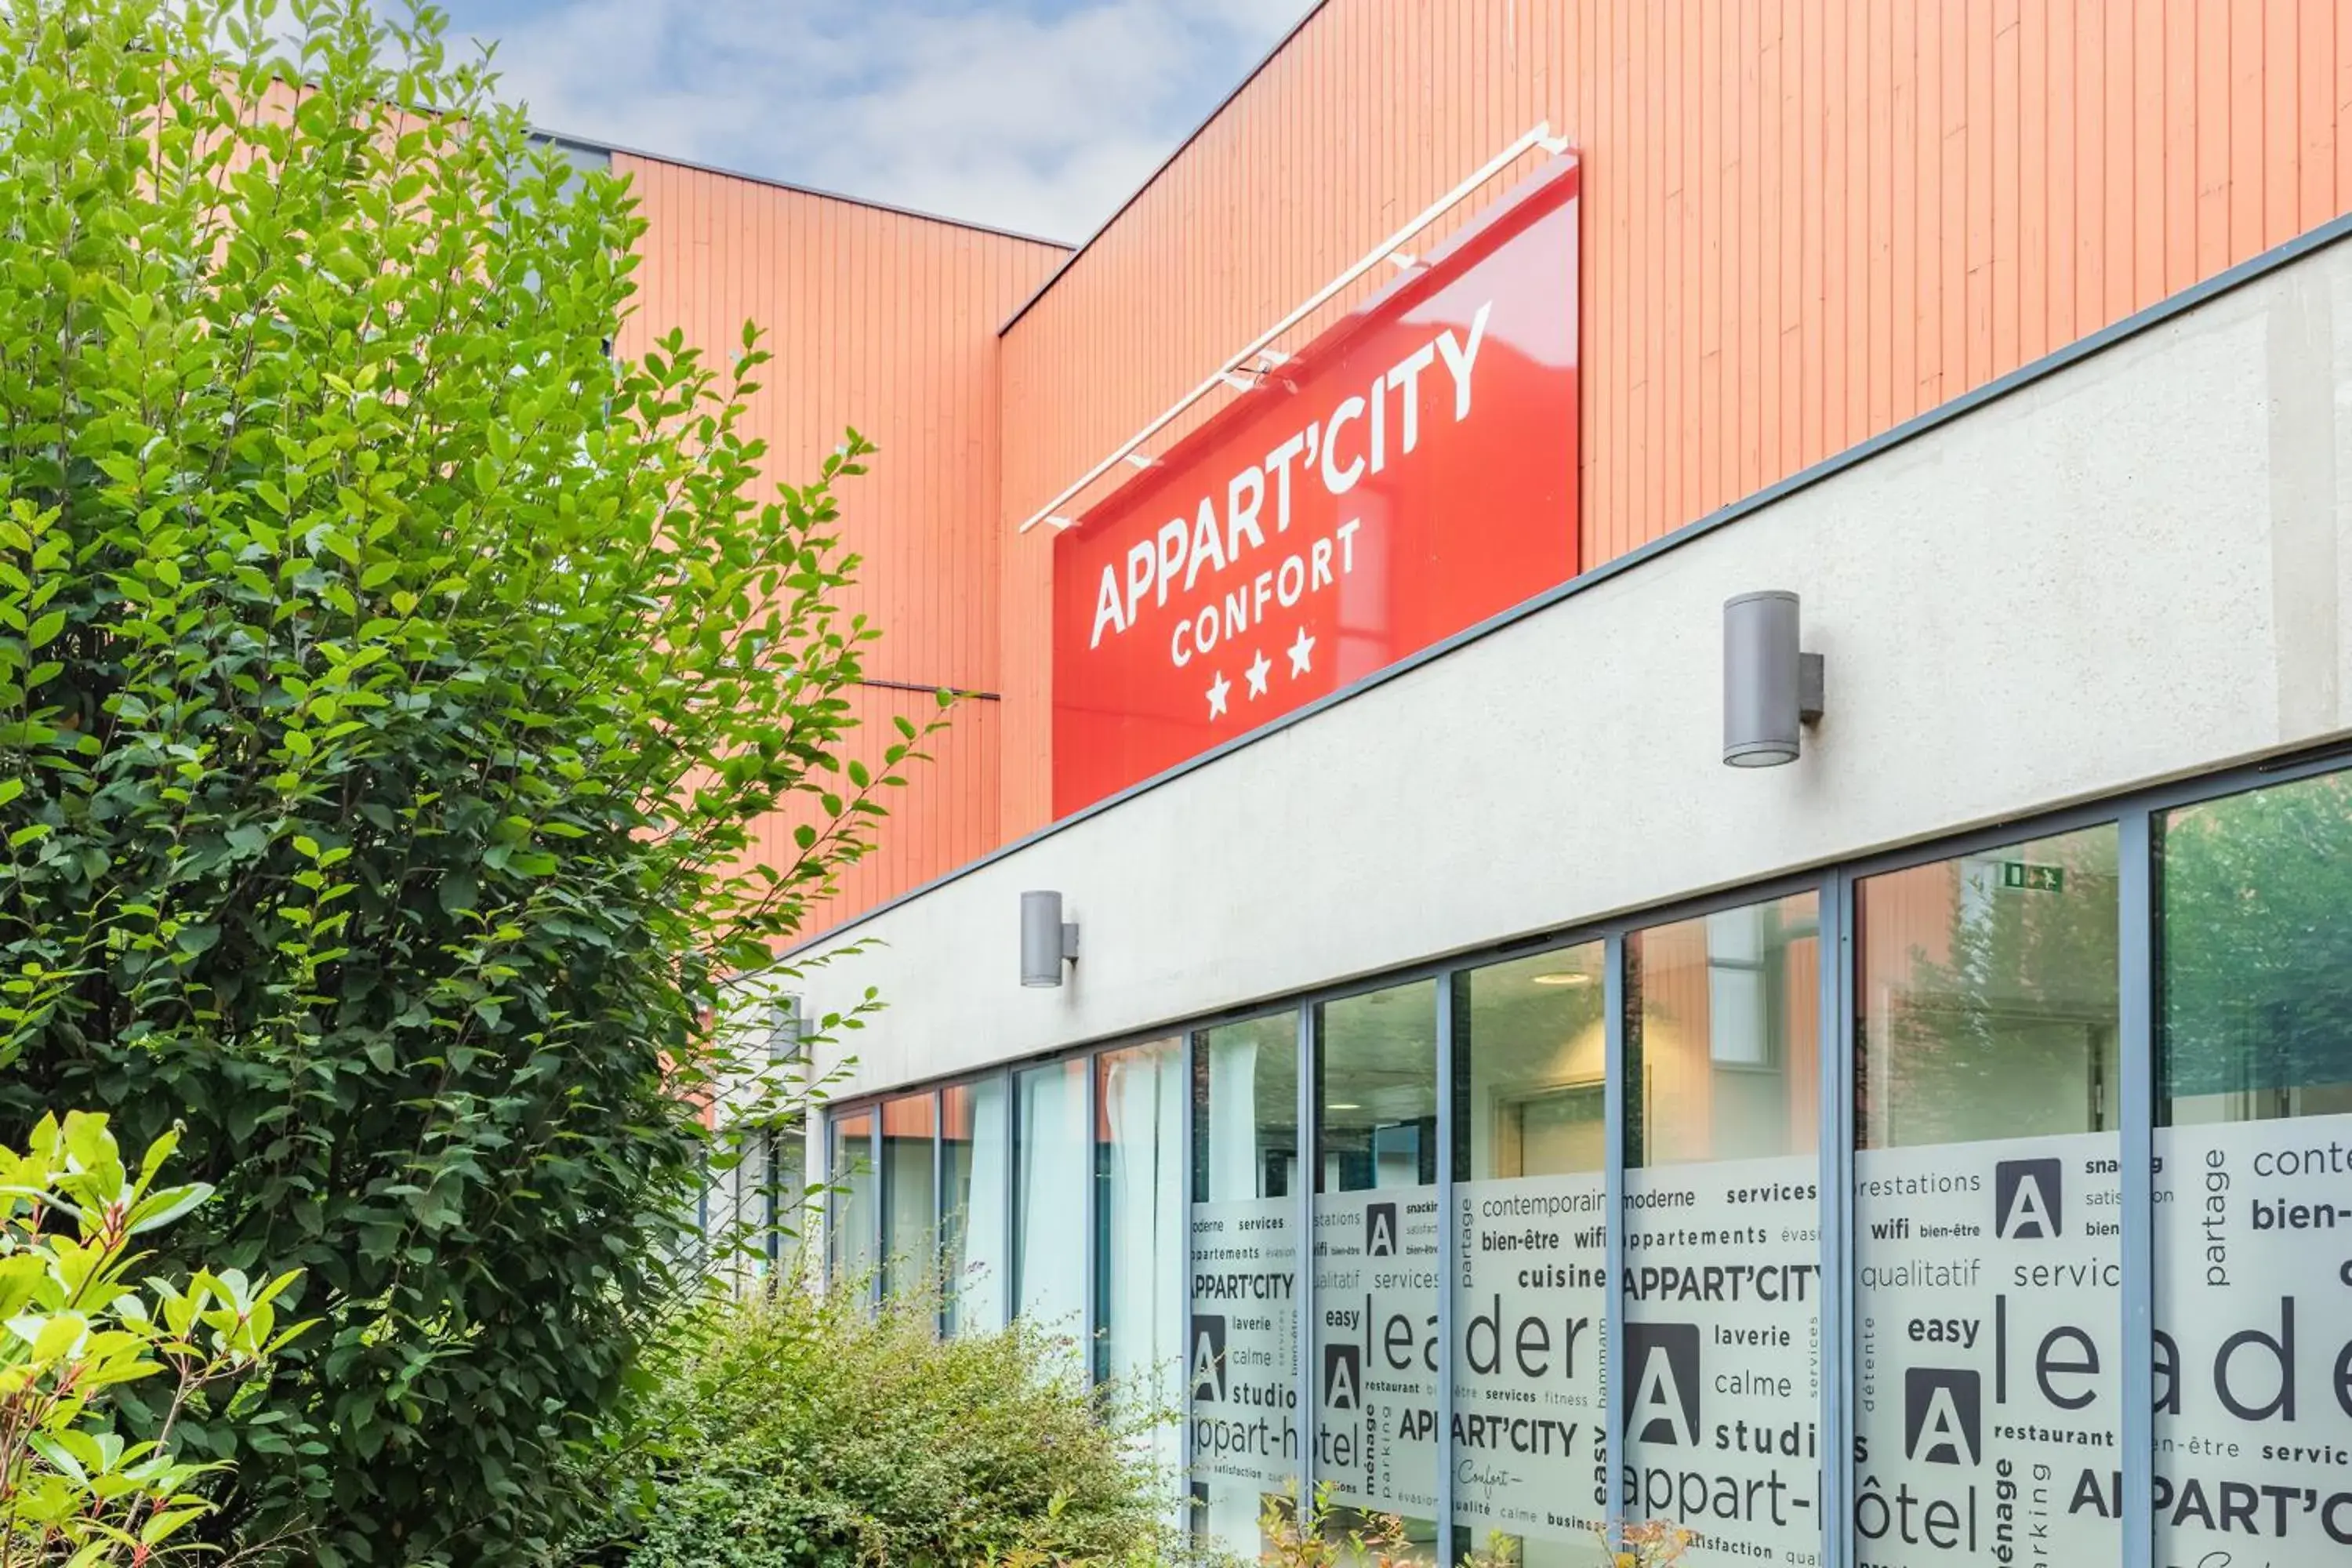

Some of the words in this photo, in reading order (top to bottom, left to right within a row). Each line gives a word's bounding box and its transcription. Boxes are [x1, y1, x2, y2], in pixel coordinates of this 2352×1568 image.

[1090, 299, 1492, 650] APPART'CITY
[1171, 518, 1360, 667] CONFORT
[2254, 1142, 2352, 1177] cont
[1622, 1189, 1695, 1209] moderne
[1726, 1183, 1817, 1203] services
[1854, 1173, 1981, 1197] restations
[1192, 1219, 1223, 1233] oderne
[1239, 1216, 1283, 1232] services
[1871, 1218, 1910, 1240] wifi
[1921, 1221, 1980, 1239] bien-être
[2201, 1149, 2230, 1287] partage
[1462, 1198, 1473, 1288] partage
[1482, 1229, 1559, 1251] bien-être
[1574, 1225, 1606, 1250] wifi
[1623, 1226, 1766, 1250] ppartements
[1192, 1247, 1260, 1262] ppartements
[1518, 1263, 1606, 1288] cuisine
[1623, 1265, 1821, 1302] APPART'CIT
[1860, 1258, 1981, 1291] qualitatif
[1232, 1316, 1271, 1330] laverie
[1326, 1309, 1359, 1329] easy
[1715, 1324, 1791, 1347] laverie
[1907, 1317, 1980, 1349] easy
[1232, 1348, 1271, 1367] calme
[1863, 1318, 1875, 1412] détente
[1996, 1294, 2352, 1422] lead
[1365, 1381, 1420, 1394] restaurant
[1486, 1388, 1536, 1403] services
[1715, 1370, 1791, 1398] calme
[1994, 1424, 2114, 1447] restaurant
[2154, 1436, 2241, 1458] n-être
[1451, 1499, 1490, 1515] ualité
[1623, 1464, 1976, 1552] appart-ôtel
[1991, 1458, 2018, 1568] énage
[2067, 1468, 2352, 1545] APART'C
[1686, 1534, 1773, 1559] atisfaction
